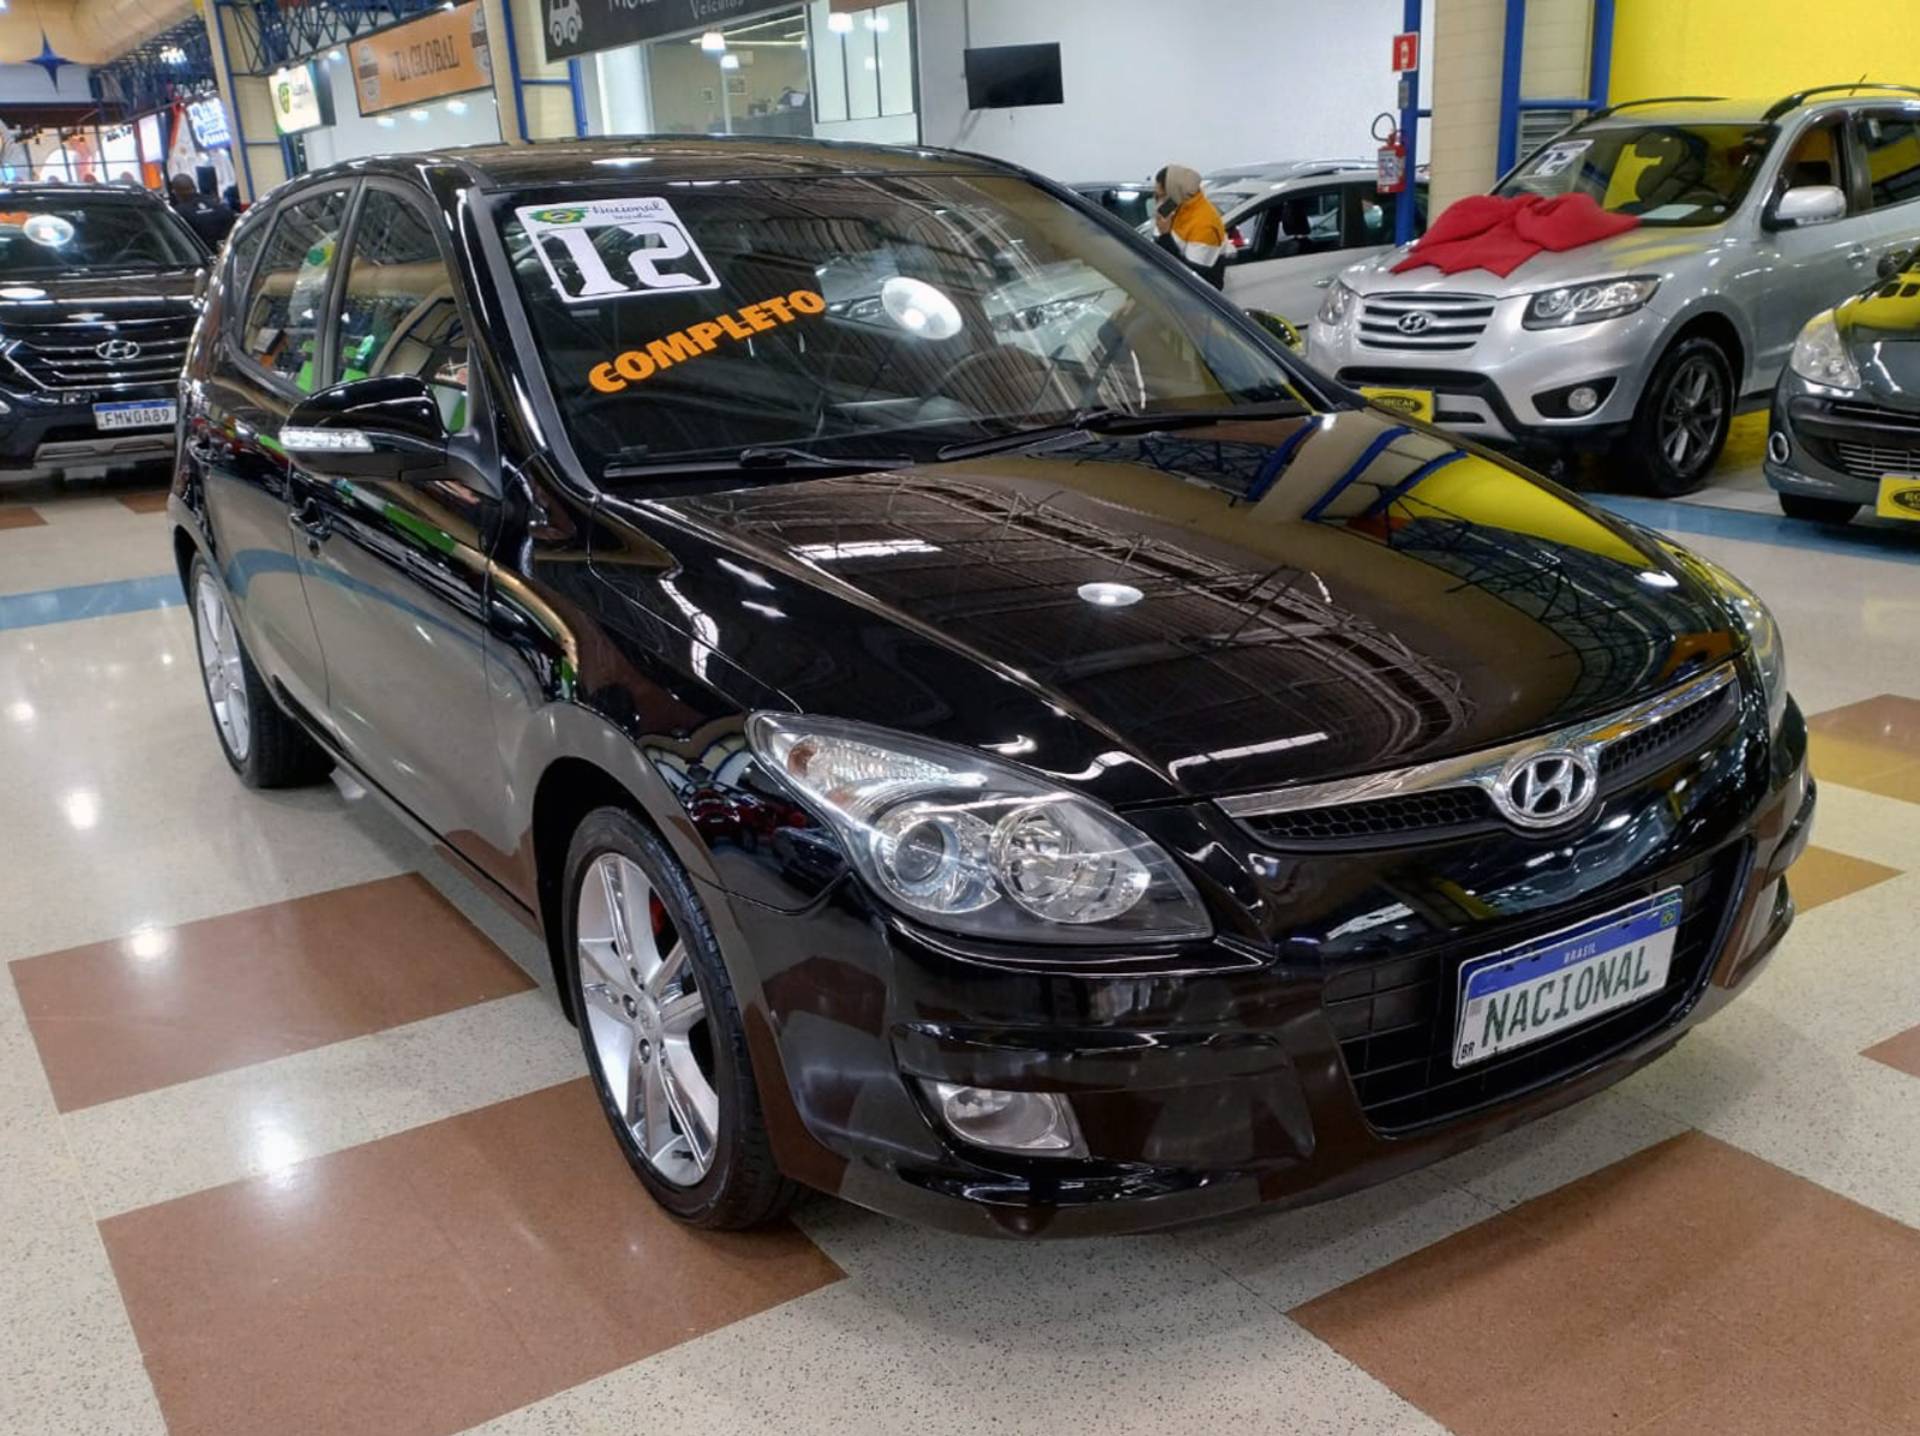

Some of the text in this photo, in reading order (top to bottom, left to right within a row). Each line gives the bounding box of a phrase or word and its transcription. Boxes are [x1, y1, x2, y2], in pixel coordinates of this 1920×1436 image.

[547, 221, 701, 296] 12
[588, 290, 827, 393] COMPLETO
[1481, 946, 1650, 1048] NACIONAL
[1563, 942, 1596, 964] BRASIL
